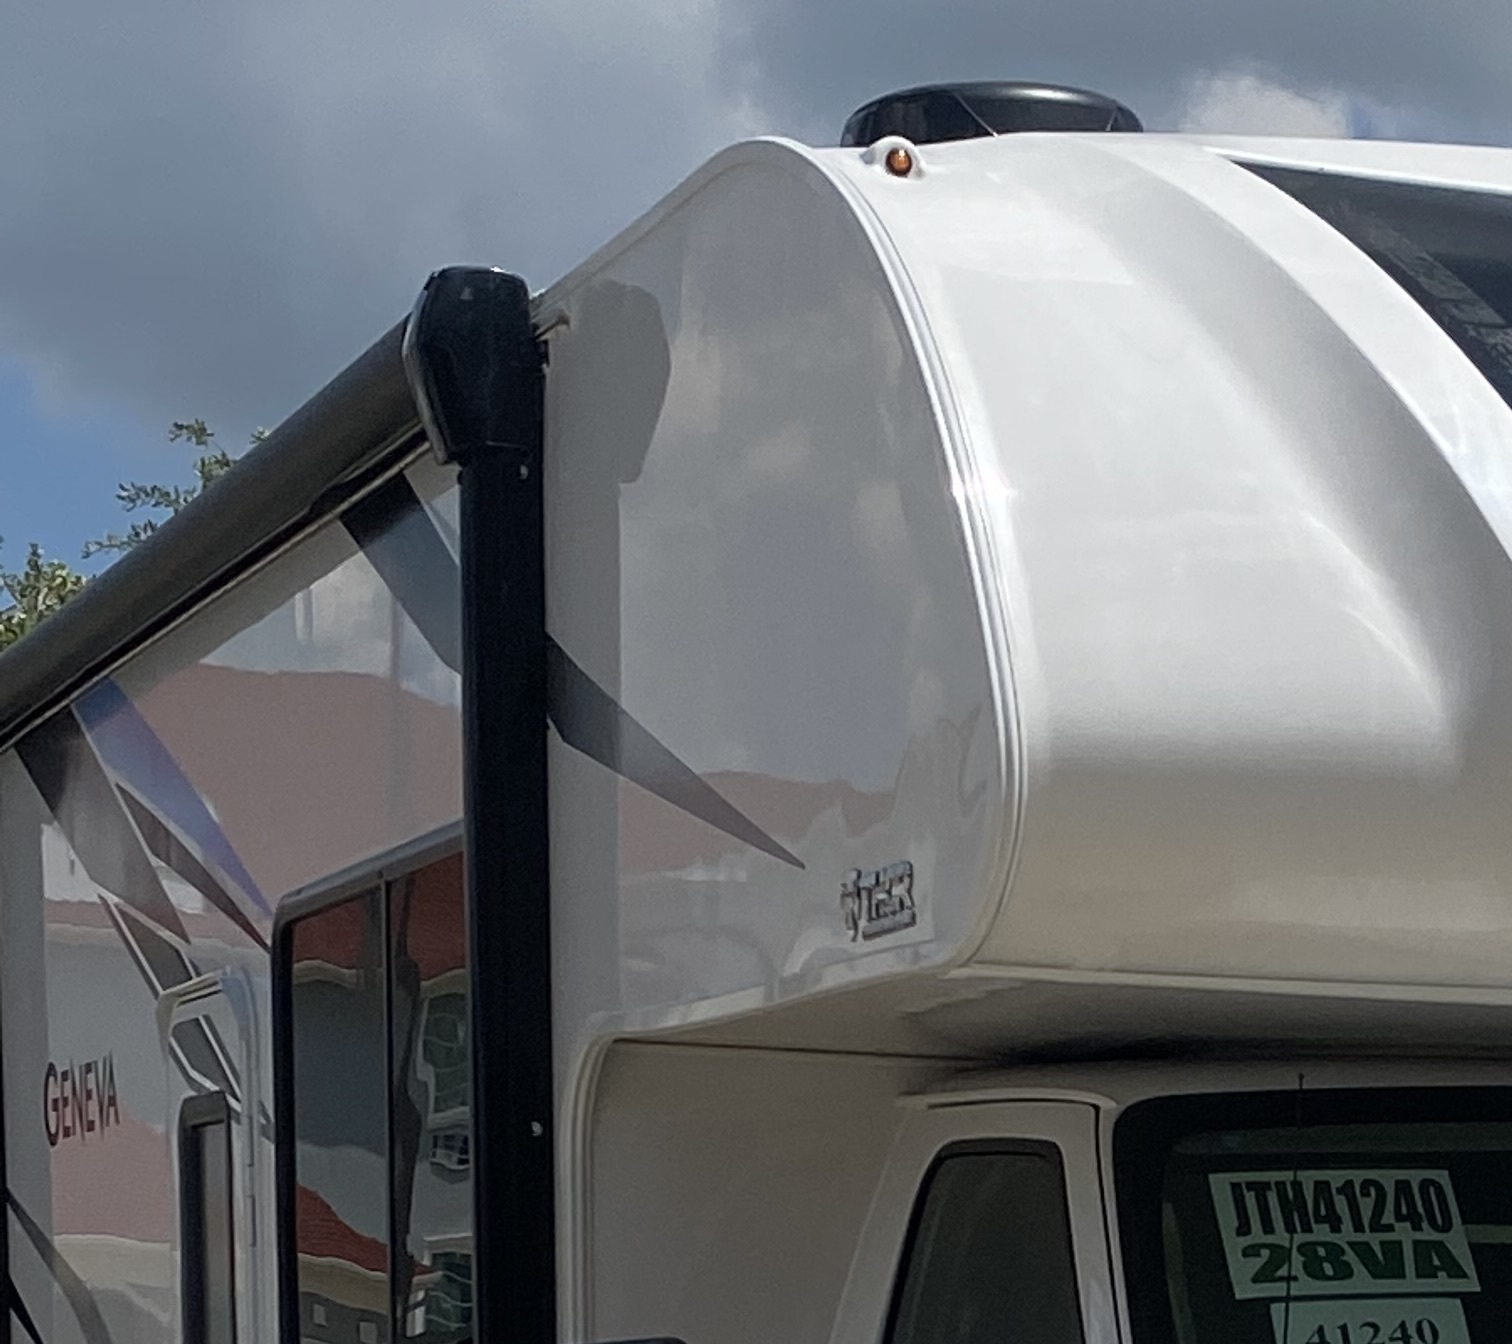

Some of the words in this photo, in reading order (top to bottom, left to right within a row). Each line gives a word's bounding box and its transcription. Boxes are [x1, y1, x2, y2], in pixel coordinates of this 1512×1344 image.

[44, 1050, 120, 1147] GENEVA
[1230, 1177, 1454, 1238] JTH41240
[1242, 1239, 1470, 1284] 28VA
